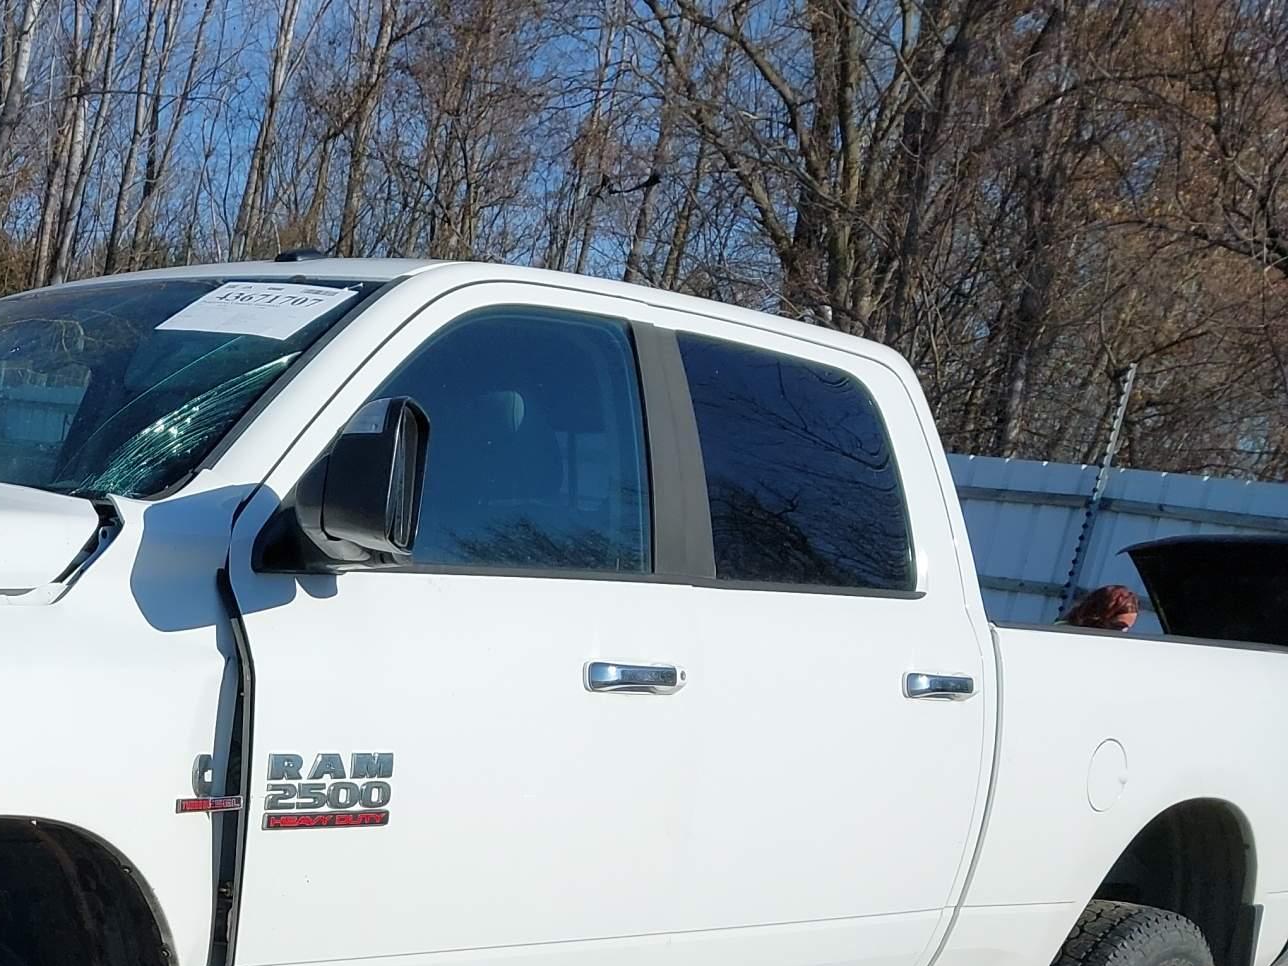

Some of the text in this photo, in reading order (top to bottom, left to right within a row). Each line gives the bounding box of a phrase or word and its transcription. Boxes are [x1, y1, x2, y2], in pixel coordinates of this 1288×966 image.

[216, 292, 324, 307] 43671707
[266, 752, 394, 781] RAM
[264, 781, 391, 810] 2500
[269, 812, 387, 828] HEAVY DUTY
